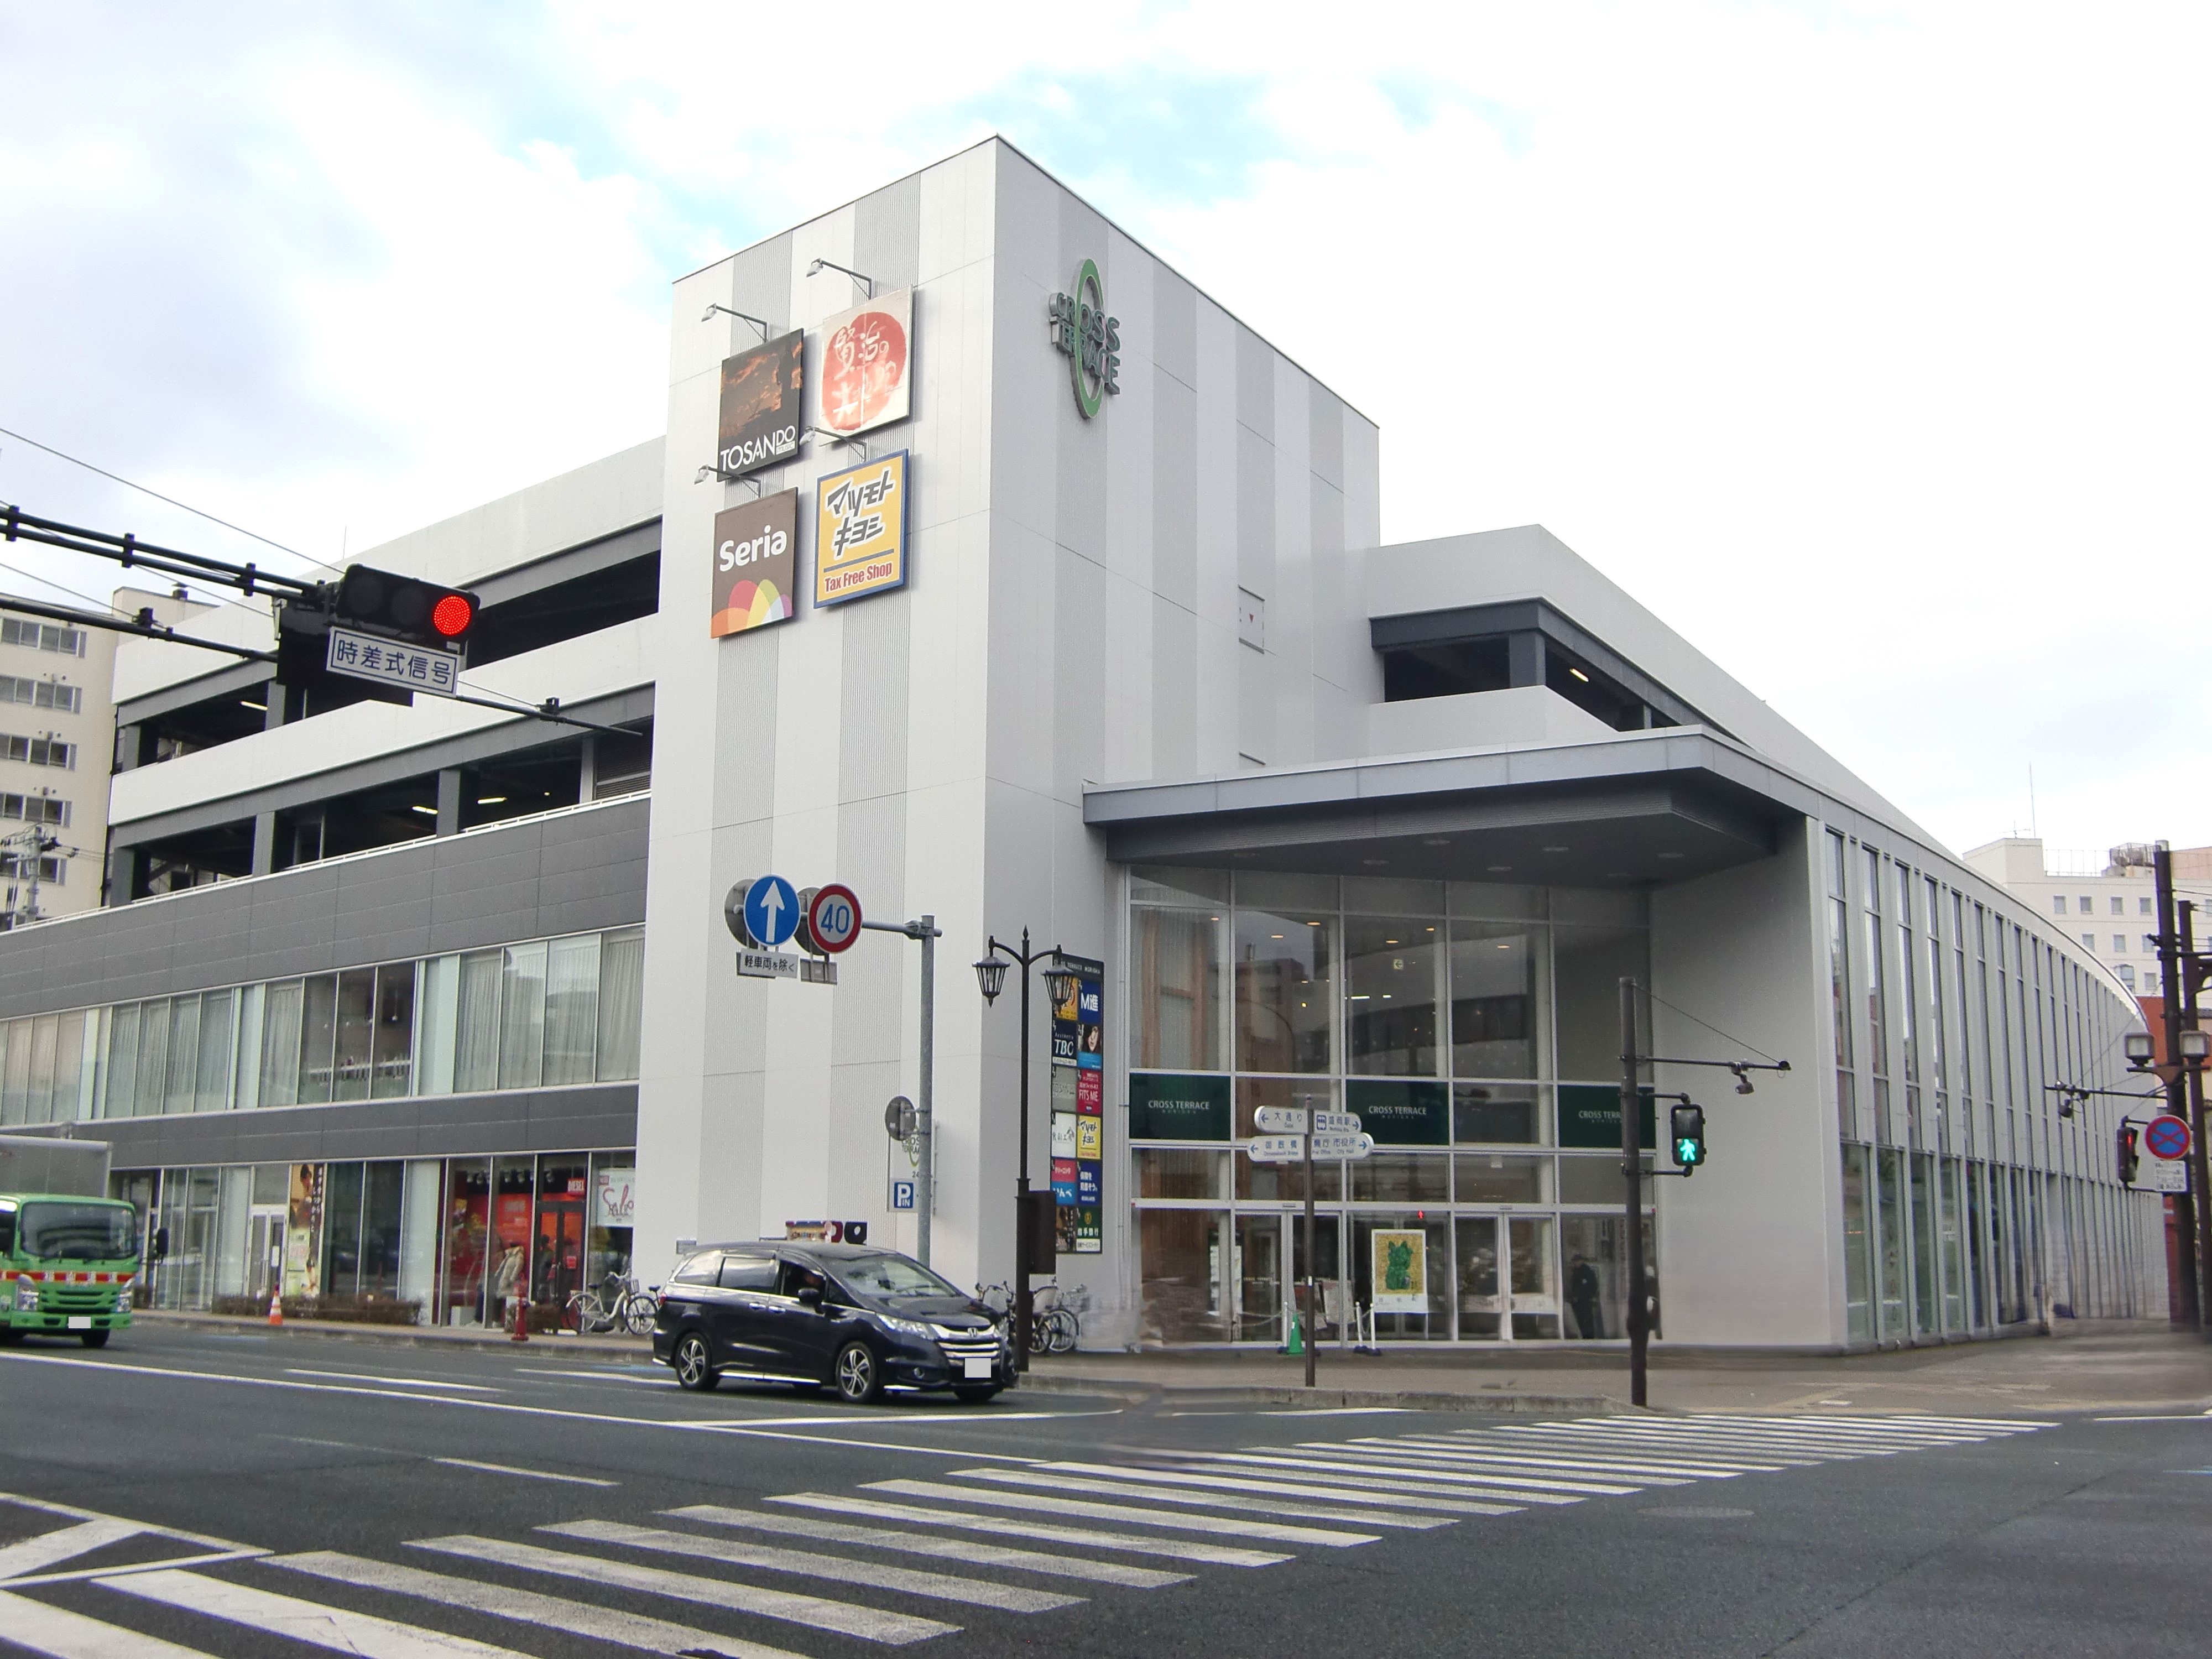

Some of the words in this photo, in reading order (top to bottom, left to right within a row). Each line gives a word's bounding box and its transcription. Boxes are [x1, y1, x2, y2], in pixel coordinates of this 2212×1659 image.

[1050, 292, 1120, 352] CROSS
[1050, 316, 1120, 395] TERRACE
[721, 425, 795, 471] TOSANDO
[827, 469, 894, 517] マツモト
[719, 525, 787, 572] Seria
[834, 517, 883, 556] キヨシ
[825, 578, 841, 592] Tax
[843, 569, 865, 587] Free
[867, 562, 892, 581] Shop
[337, 639, 451, 685] 時差式信号
[821, 903, 849, 934] 40
[744, 954, 795, 972] 軽車両を除く
[1054, 1039, 1074, 1056] TBC
[1079, 1089, 1089, 1101] FITS
[1090, 1090, 1098, 1102] ME
[1149, 1100, 1173, 1108] CROSS
[1176, 1100, 1210, 1109] TERRACE
[1369, 1105, 1393, 1114] CROSS
[1394, 1107, 1427, 1115] TERRACE
[1274, 1111, 1302, 1122] 大通り
[897, 1183, 911, 1207] P
